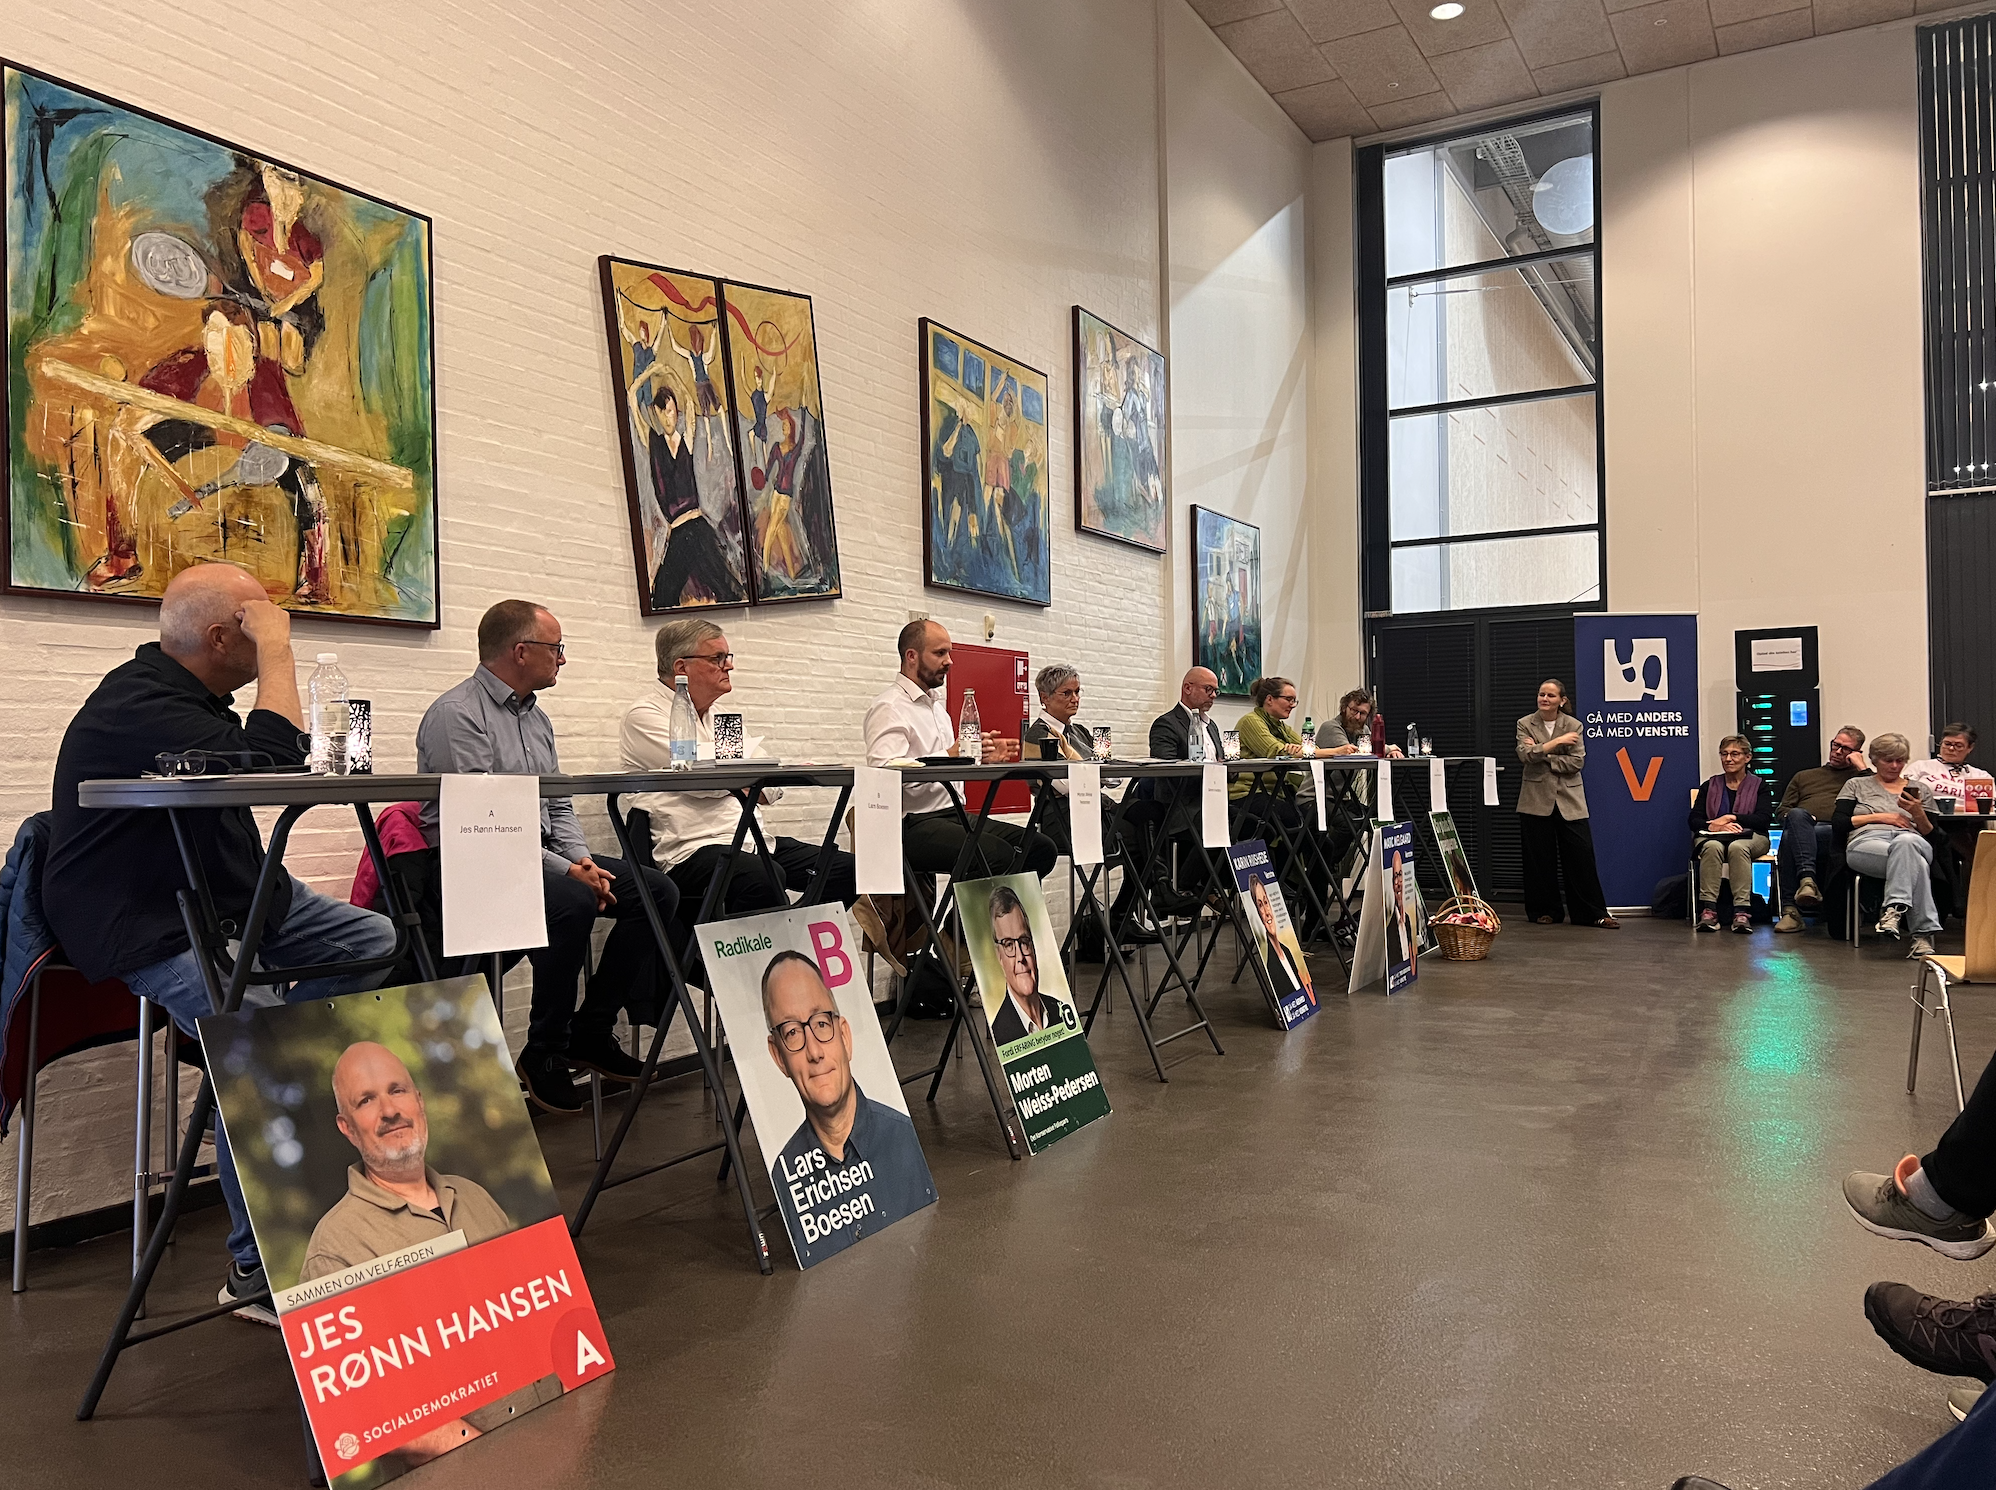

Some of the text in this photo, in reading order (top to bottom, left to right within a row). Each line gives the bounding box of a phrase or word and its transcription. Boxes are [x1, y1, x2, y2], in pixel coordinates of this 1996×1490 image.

[1586, 710, 1682, 723] GÅ MED ANDERS
[1586, 725, 1690, 738] GÅ MED VENSTRE
[1615, 746, 1664, 801] V
[1934, 783, 1965, 797] PARI
[459, 825, 523, 833] Jes Rønn Hansen
[488, 809, 495, 817] A
[714, 932, 773, 958] Radikale
[807, 921, 853, 989] B
[1064, 1008, 1075, 1026] C
[1010, 1063, 1053, 1094] Morten
[1018, 1070, 1099, 1120] Weiss-Pedersen
[779, 1147, 826, 1183] Lars
[789, 1160, 875, 1214] Erichsen
[799, 1193, 875, 1245] Boesen
[286, 1246, 435, 1307] SAMMEN OM VELFÆRDEN
[299, 1305, 363, 1359] JES
[310, 1269, 573, 1404] RØNN HANSEN
[576, 1329, 606, 1376] A
[363, 1371, 500, 1444] SOCIALDEMOKRATIET
